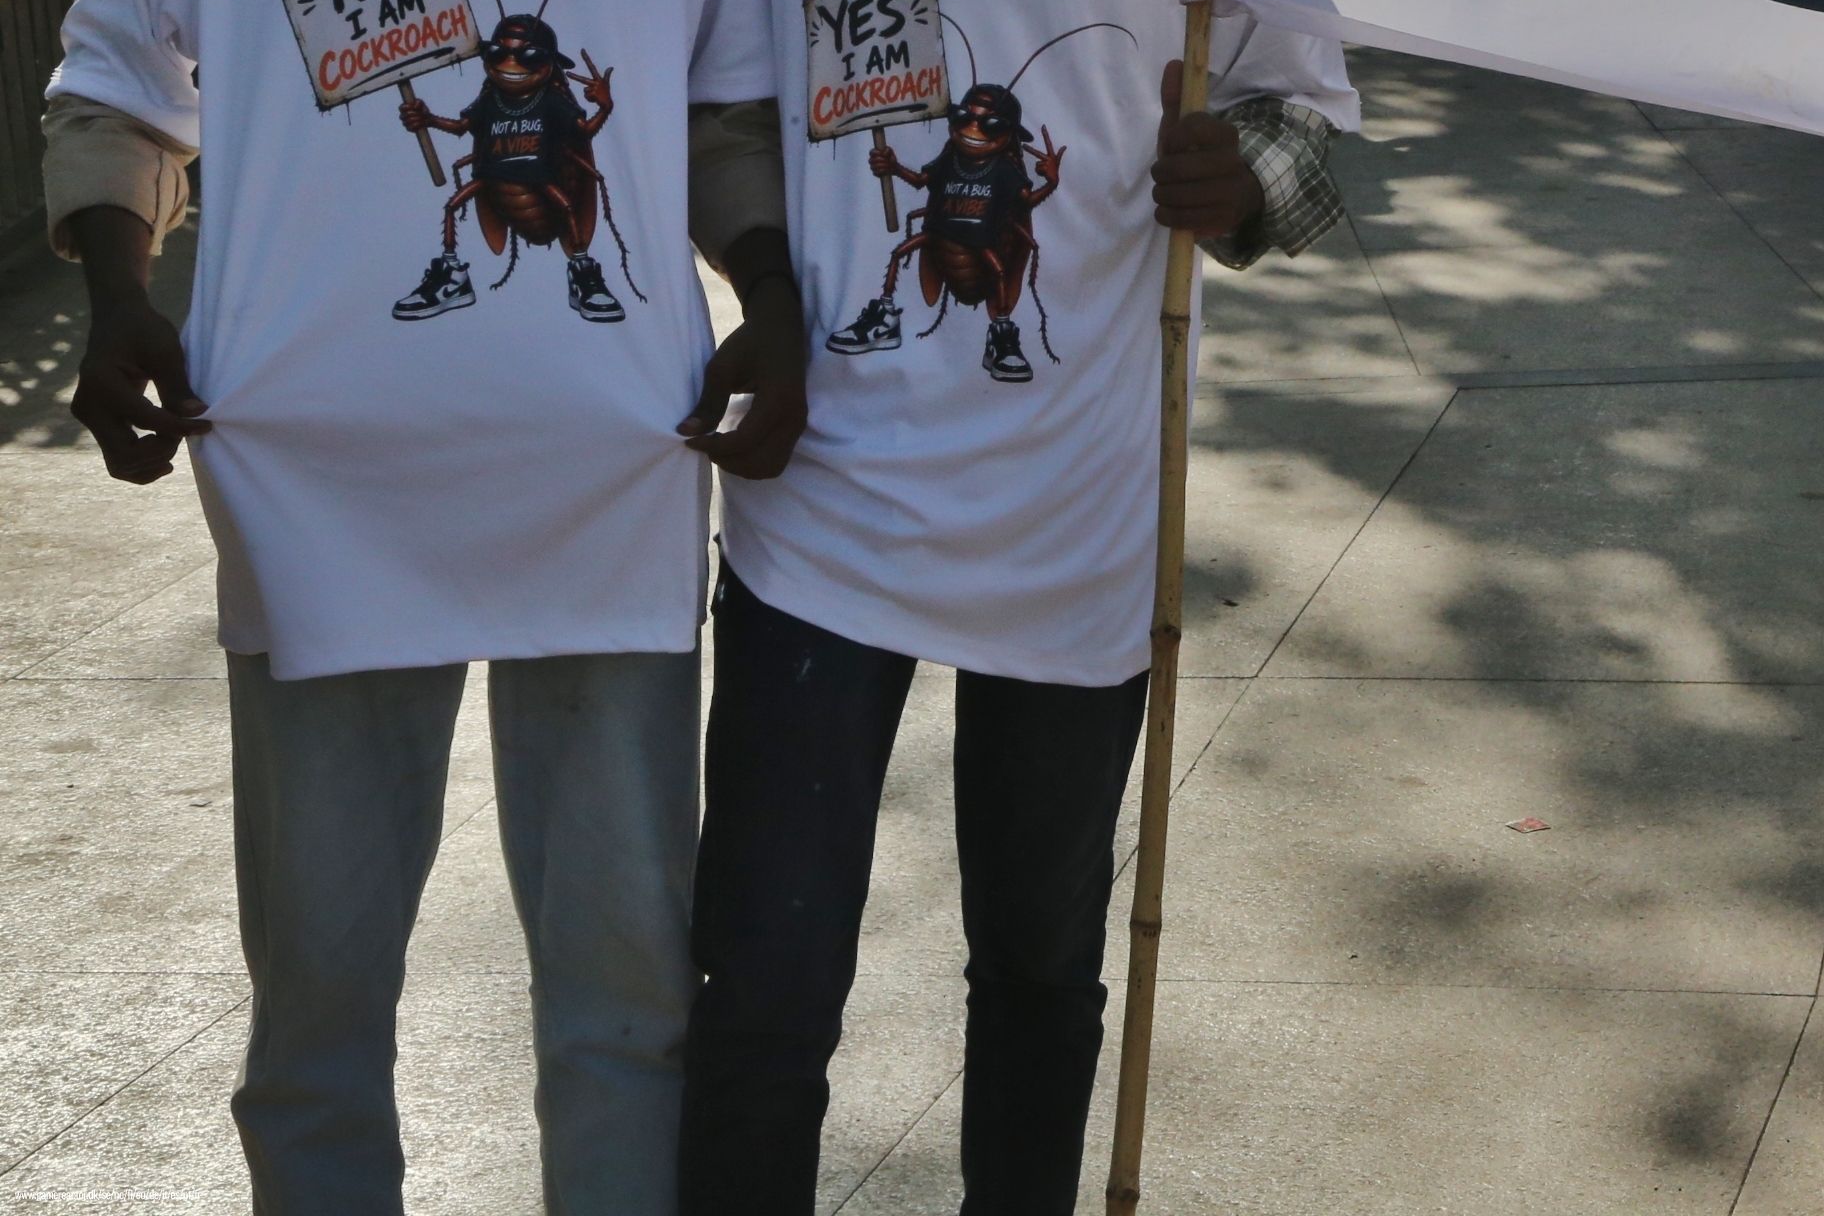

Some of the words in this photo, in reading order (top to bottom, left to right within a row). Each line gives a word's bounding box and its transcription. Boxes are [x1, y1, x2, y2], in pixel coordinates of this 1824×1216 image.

[346, 8, 367, 40] I
[318, 5, 468, 91] COCKROACH
[841, 51, 855, 81] I
[866, 41, 910, 75] AM
[813, 65, 942, 126] COCKROACH
[491, 121, 511, 135] NOT
[511, 121, 518, 134] A
[521, 119, 544, 133] BUG.
[507, 136, 541, 153] VIBE
[944, 182, 963, 194] NOT
[962, 184, 968, 196] A
